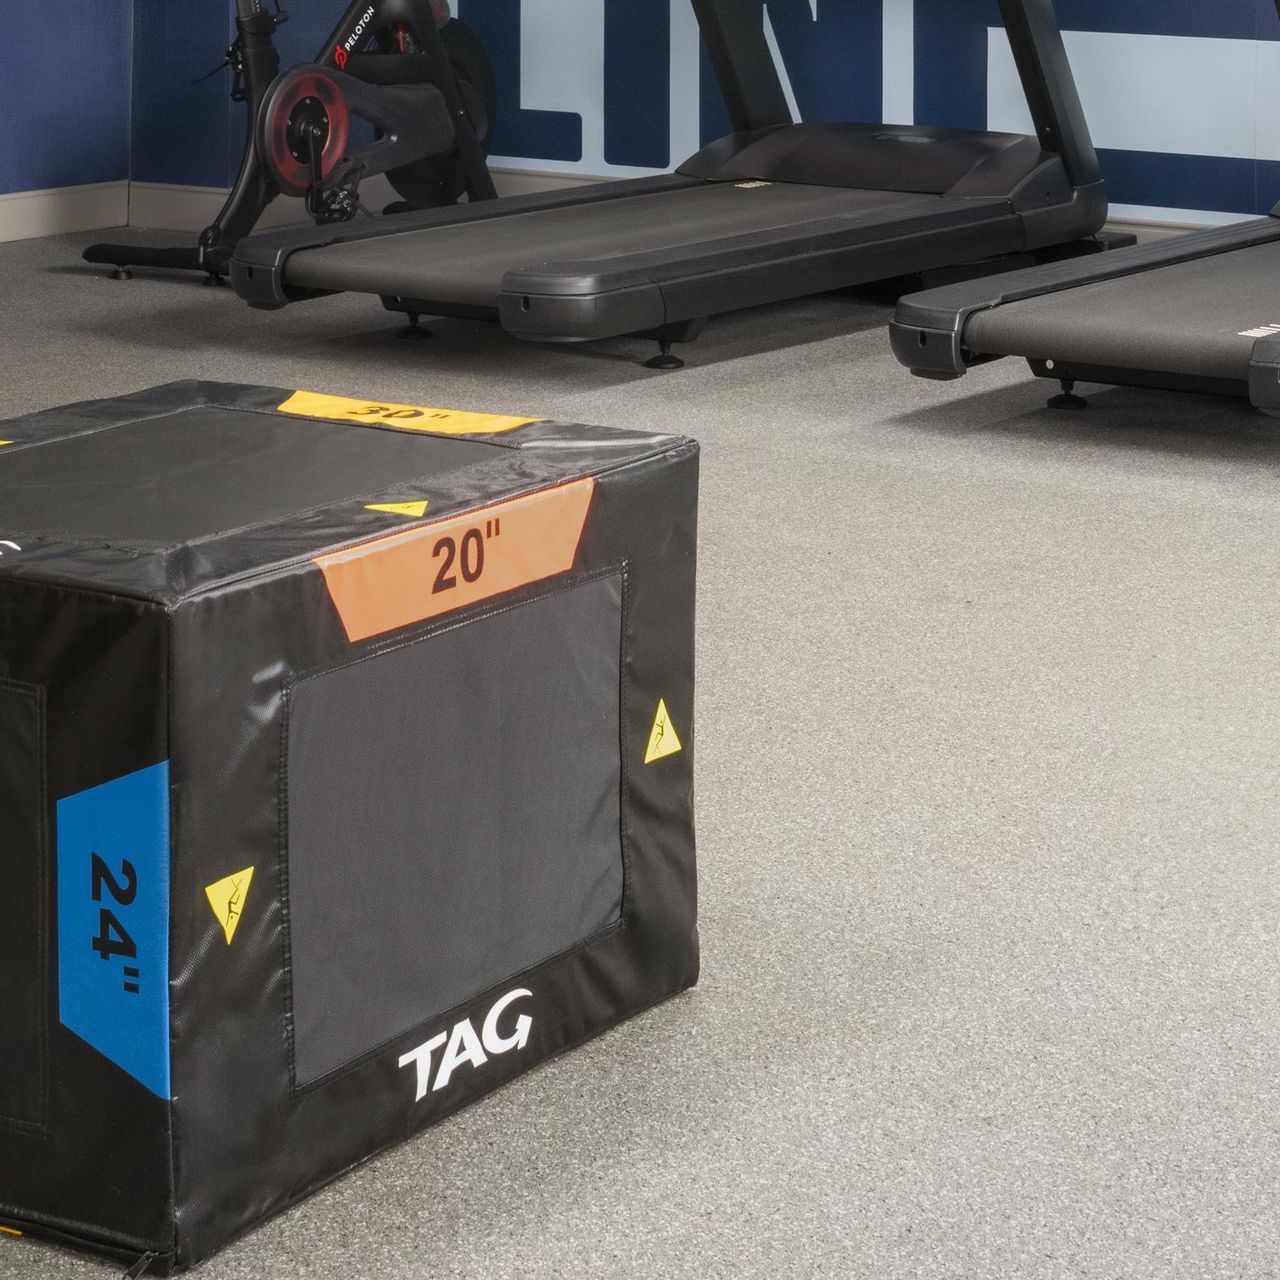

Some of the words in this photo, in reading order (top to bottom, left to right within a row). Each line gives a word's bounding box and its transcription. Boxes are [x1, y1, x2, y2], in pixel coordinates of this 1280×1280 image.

[344, 5, 376, 52] PELOTON
[347, 405, 451, 420] 30"
[431, 517, 501, 595] 20"
[90, 851, 139, 995] 24"
[398, 988, 533, 1103] TAG
